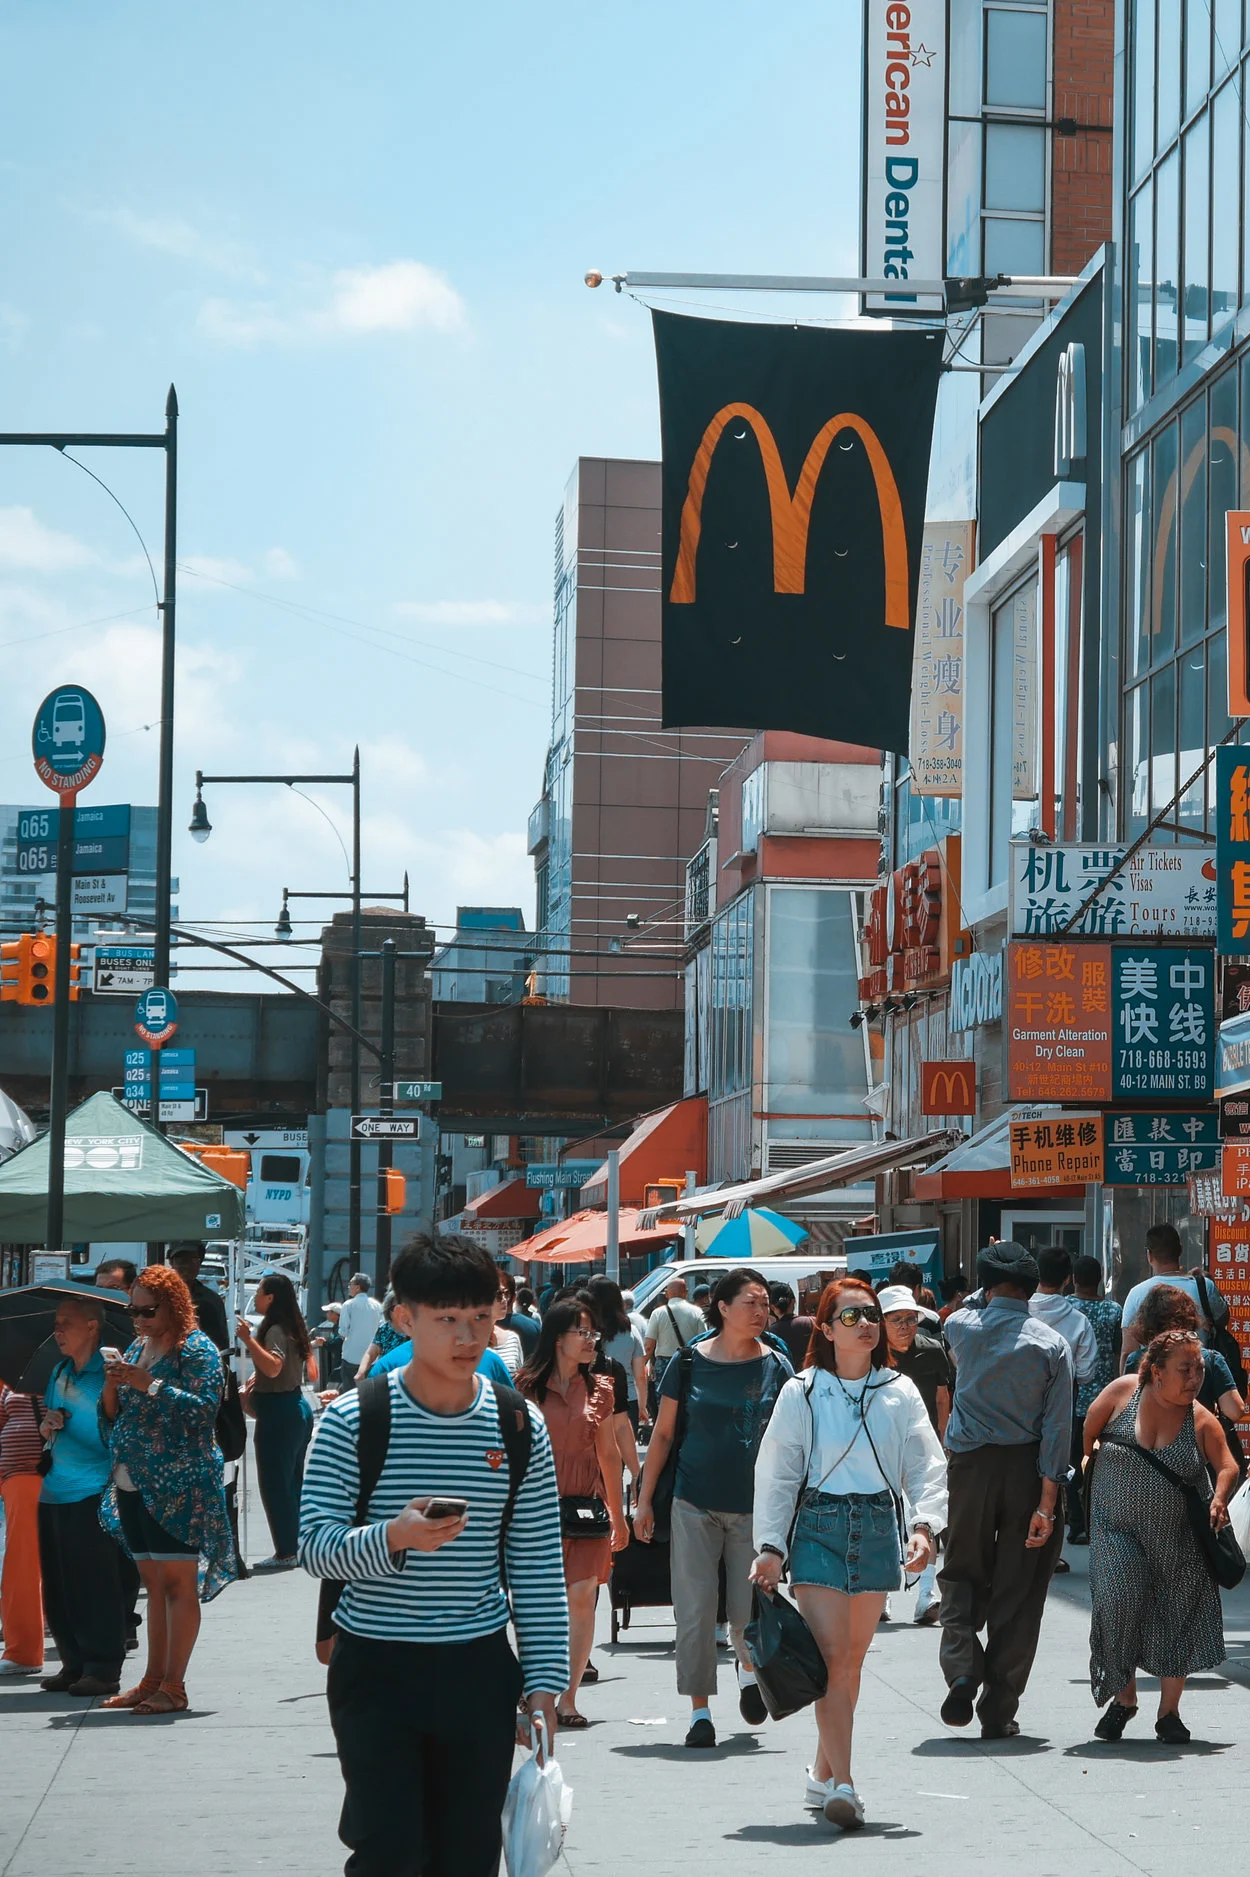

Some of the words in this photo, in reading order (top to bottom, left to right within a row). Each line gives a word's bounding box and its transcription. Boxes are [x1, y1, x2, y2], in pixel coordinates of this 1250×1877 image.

[885, 0, 912, 146] erican
[918, 544, 934, 647] Professional
[932, 540, 965, 752] 专业瘦身
[917, 756, 963, 771] 718-358-3040
[38, 759, 52, 780] NO
[51, 757, 98, 789] STANDING
[20, 813, 50, 839] Q65
[75, 810, 105, 823] Jamaica
[19, 846, 49, 871] Q65
[75, 843, 104, 855] Jamaica
[1147, 851, 1183, 872] Tickets
[1020, 847, 1127, 894] 机票
[74, 878, 91, 891] Main
[1129, 872, 1154, 892] Visas
[1129, 902, 1176, 921] Tours
[99, 958, 132, 967] BUSES
[115, 949, 134, 958] BUS
[1013, 946, 1077, 981] 修改
[117, 976, 135, 985] 7AM
[1119, 957, 1206, 1001] 美中
[1014, 990, 1077, 1025] 干洗
[1119, 1001, 1207, 1046] 快线
[1012, 1028, 1057, 1042] Garment
[1057, 1028, 1109, 1042] Alteration
[126, 1052, 146, 1065] Q25
[1035, 1045, 1052, 1060] Dry
[1052, 1045, 1085, 1058] Clean
[1119, 1049, 1207, 1070] 718-668-5593
[126, 1068, 145, 1081] Q25
[1120, 1074, 1148, 1090] 40-12
[1149, 1074, 1175, 1090] MAIN
[1177, 1074, 1191, 1090] ST.
[1193, 1074, 1207, 1090] B9
[126, 1084, 145, 1097] Q34
[406, 1084, 421, 1097] 40
[127, 1100, 152, 1110] ONE
[361, 1122, 381, 1132] ONE
[389, 1122, 411, 1133] WAY
[1011, 1121, 1098, 1152] 手机维修
[117, 1137, 140, 1145] CITY
[1012, 1154, 1053, 1174] Phone
[1057, 1151, 1101, 1173] Repair
[526, 1169, 554, 1187] Flushing
[555, 1171, 572, 1184] Main
[265, 1188, 293, 1202] NYPD
[1214, 1226, 1248, 1241] Discount
